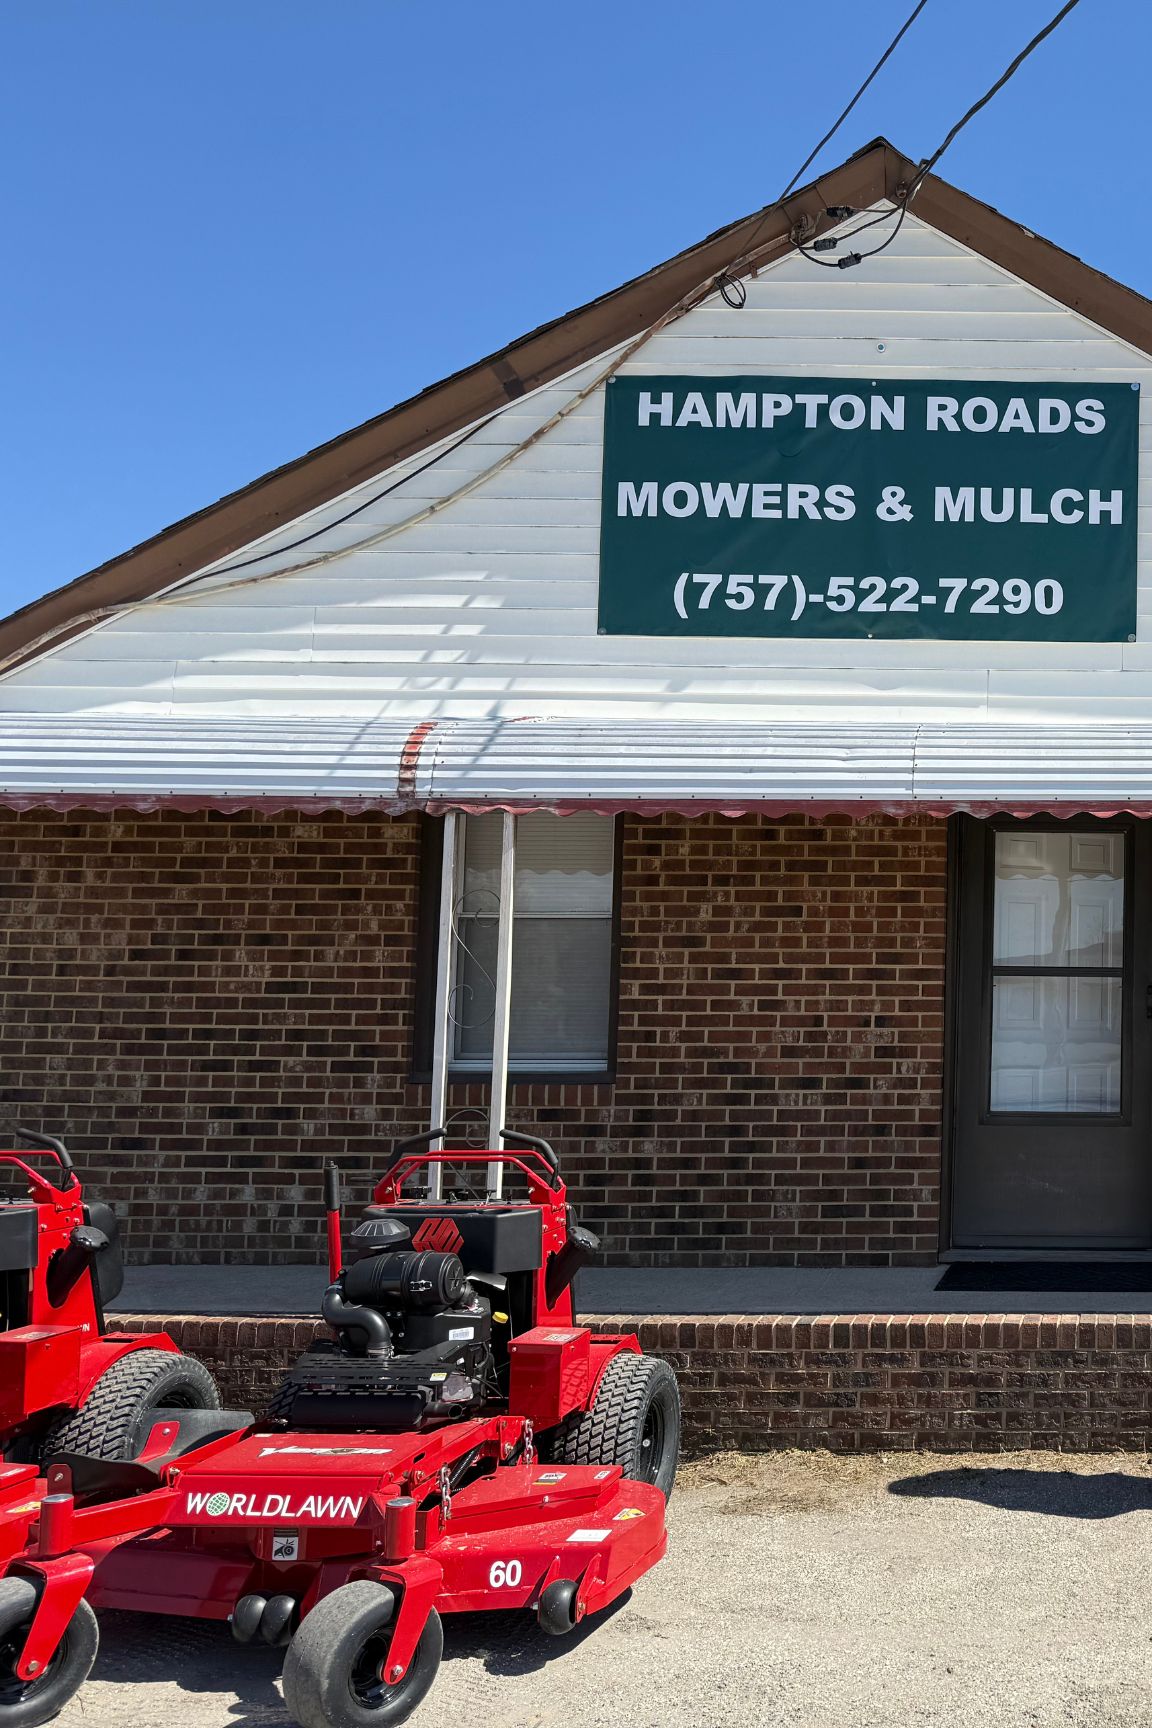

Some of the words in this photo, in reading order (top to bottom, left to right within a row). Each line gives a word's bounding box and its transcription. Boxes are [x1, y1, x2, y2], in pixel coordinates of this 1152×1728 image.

[638, 391, 905, 431] HAMPTON
[926, 396, 1106, 435] ROADS
[617, 481, 856, 521] MOWERS
[876, 485, 914, 522] &
[934, 486, 1123, 525] MULCH
[673, 572, 1064, 621] (757)-522-7290
[187, 1492, 364, 1519] WORLDLAWN
[489, 1559, 523, 1588] 60
